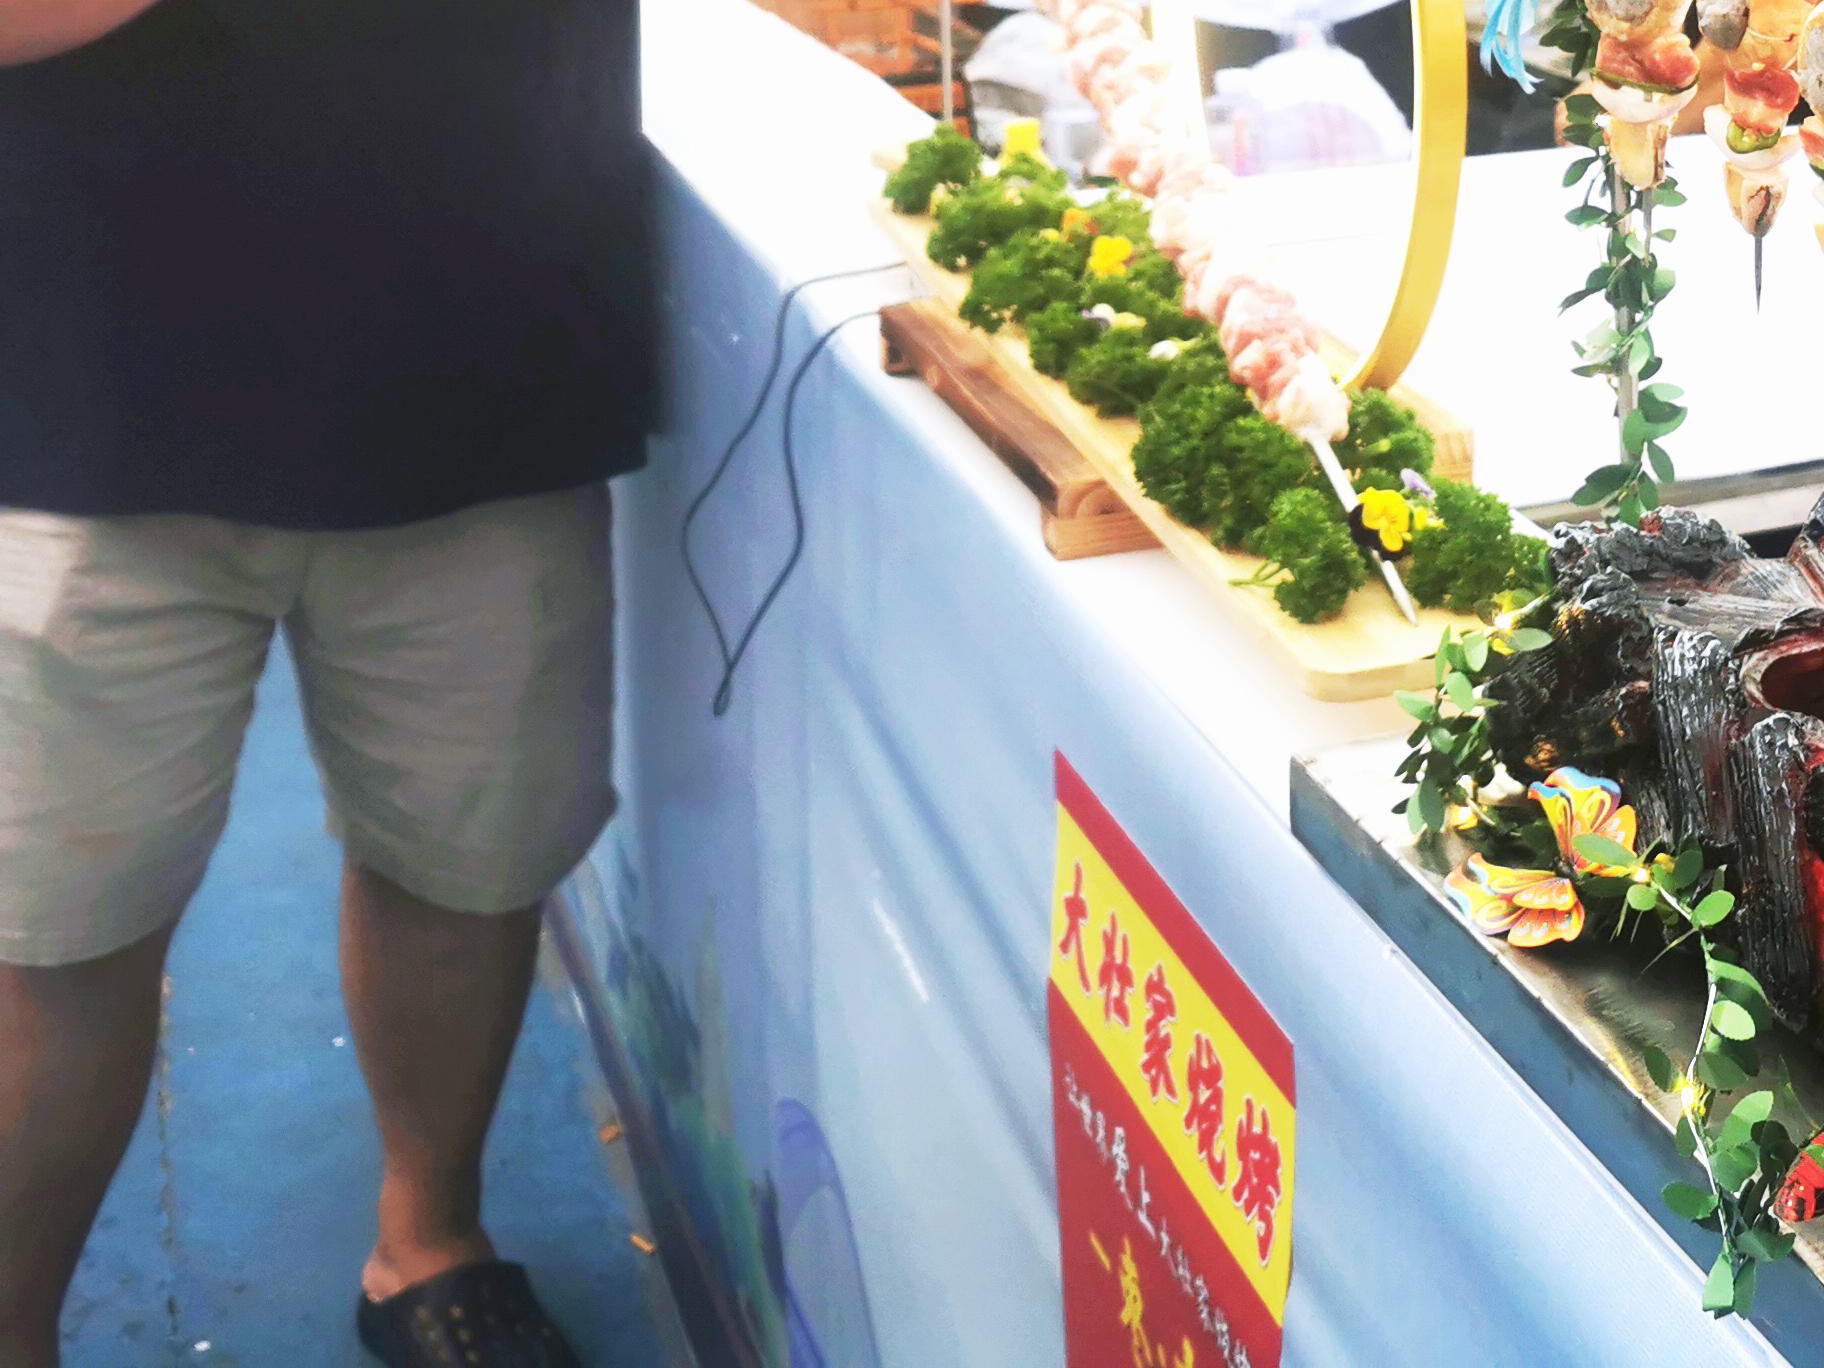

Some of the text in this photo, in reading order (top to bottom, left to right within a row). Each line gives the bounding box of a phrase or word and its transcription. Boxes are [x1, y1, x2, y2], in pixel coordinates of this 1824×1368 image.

[1059, 860, 1282, 1267] 大壮家烧烤
